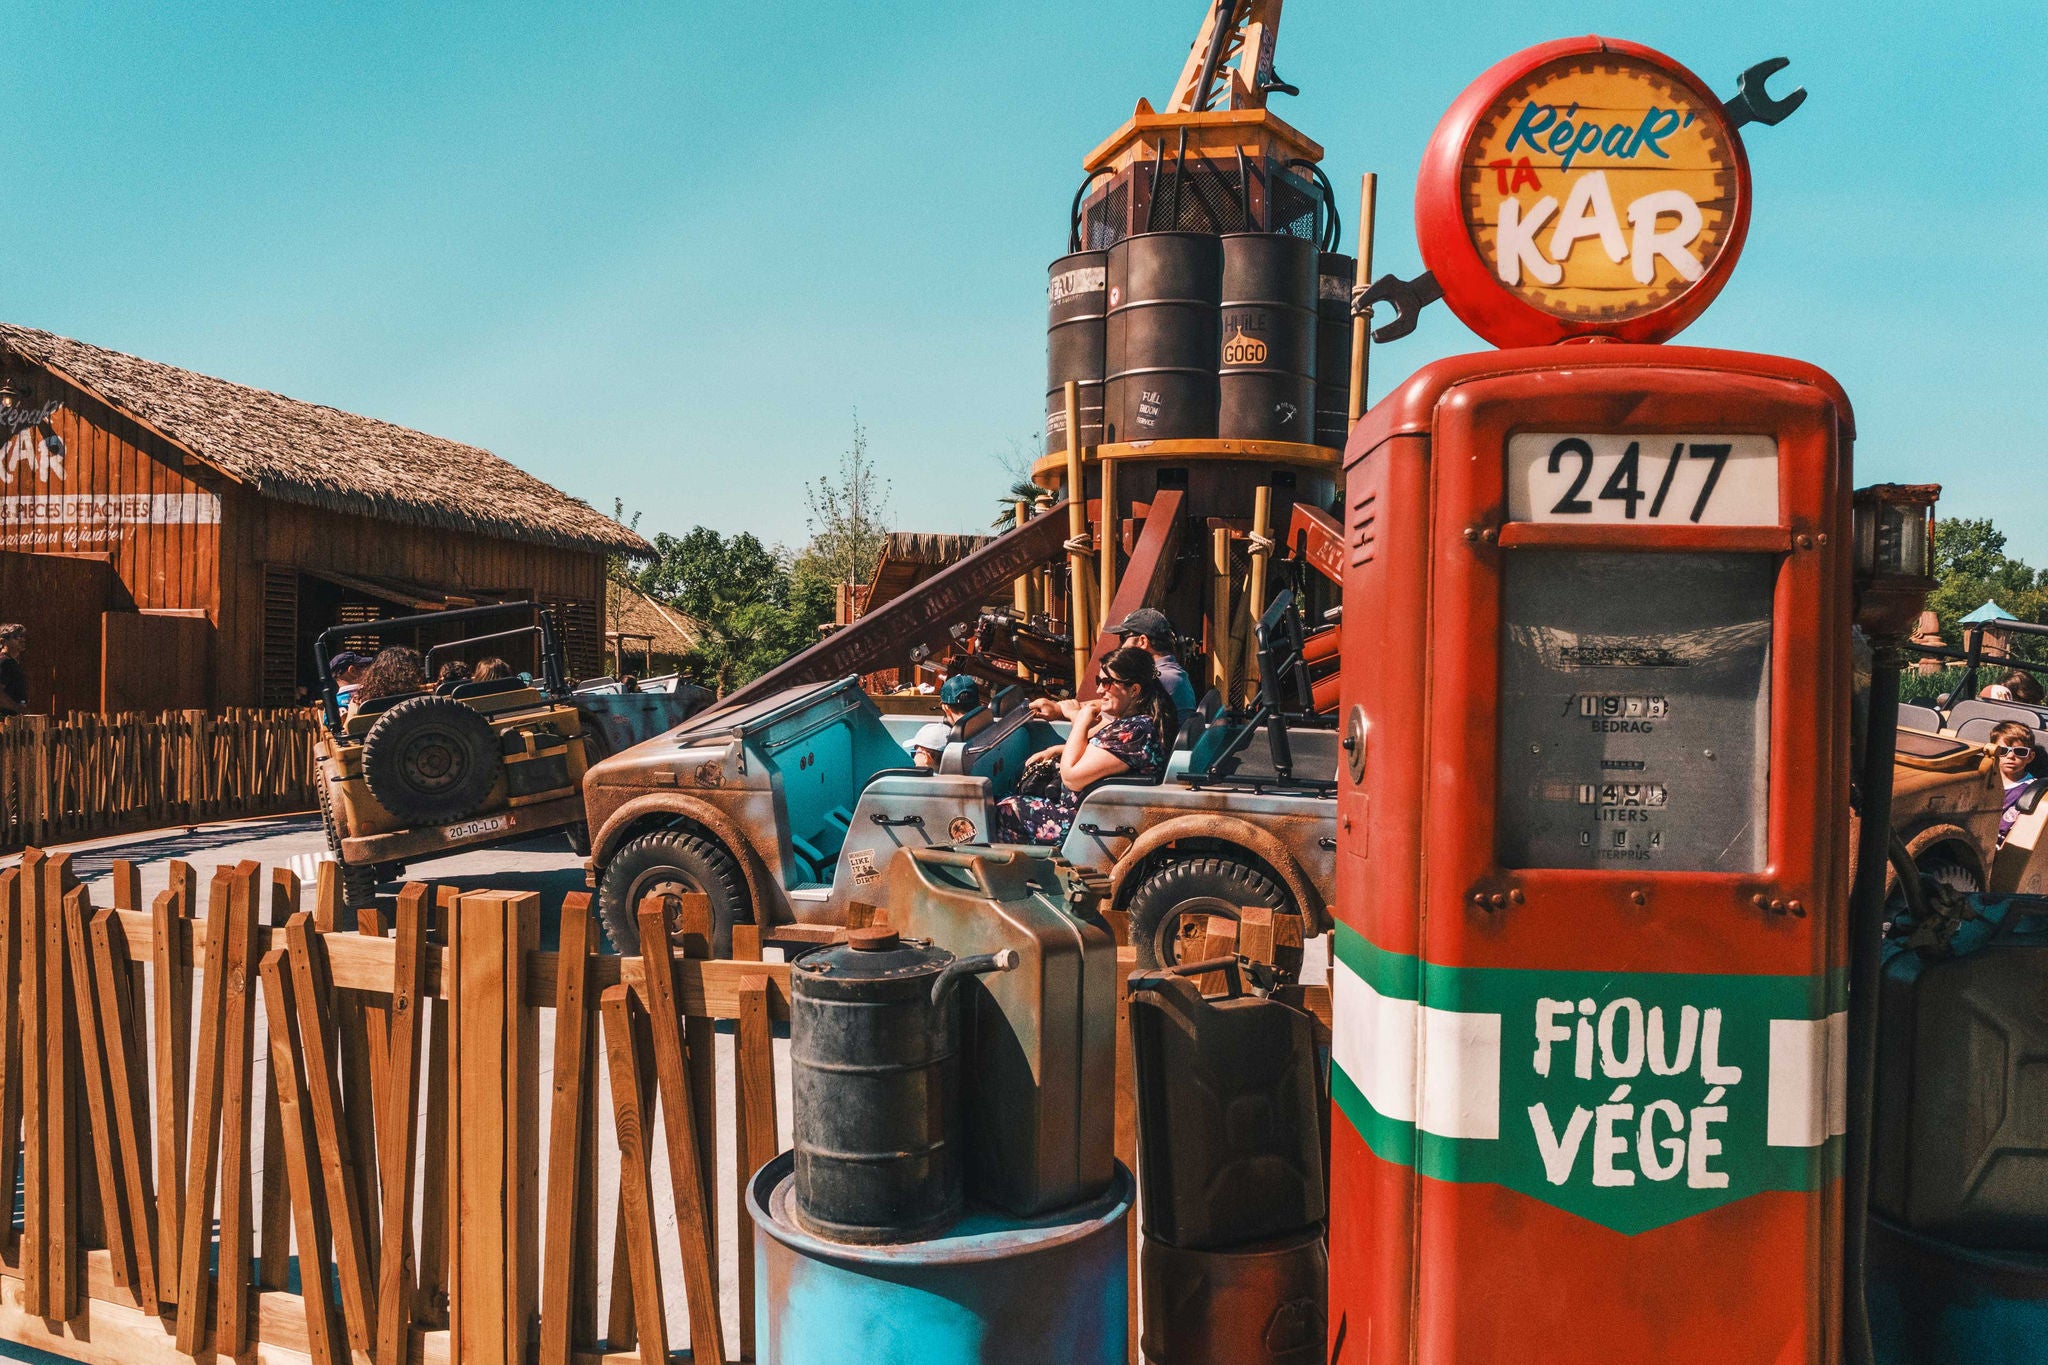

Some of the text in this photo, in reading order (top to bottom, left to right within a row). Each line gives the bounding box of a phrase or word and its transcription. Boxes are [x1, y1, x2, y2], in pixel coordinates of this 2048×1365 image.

[1489, 157, 1542, 195] TA
[1497, 170, 1705, 286] KAR
[1050, 274, 1075, 298] EAU
[1224, 344, 1265, 362] GOGO
[1142, 391, 1160, 404] FULL
[1139, 404, 1159, 415] BIDON
[1136, 416, 1155, 427] SERVICE
[1547, 437, 1732, 523] 24/7
[0, 502, 10, 519] &
[66, 497, 149, 518] DÉTACHÉES
[1591, 721, 1653, 733] BEDRAG
[1595, 809, 1648, 821] LITERS
[449, 819, 499, 838] 20-10-LD
[850, 857, 870, 866] LIKE
[1527, 1084, 1729, 1189] VÉGÉ
